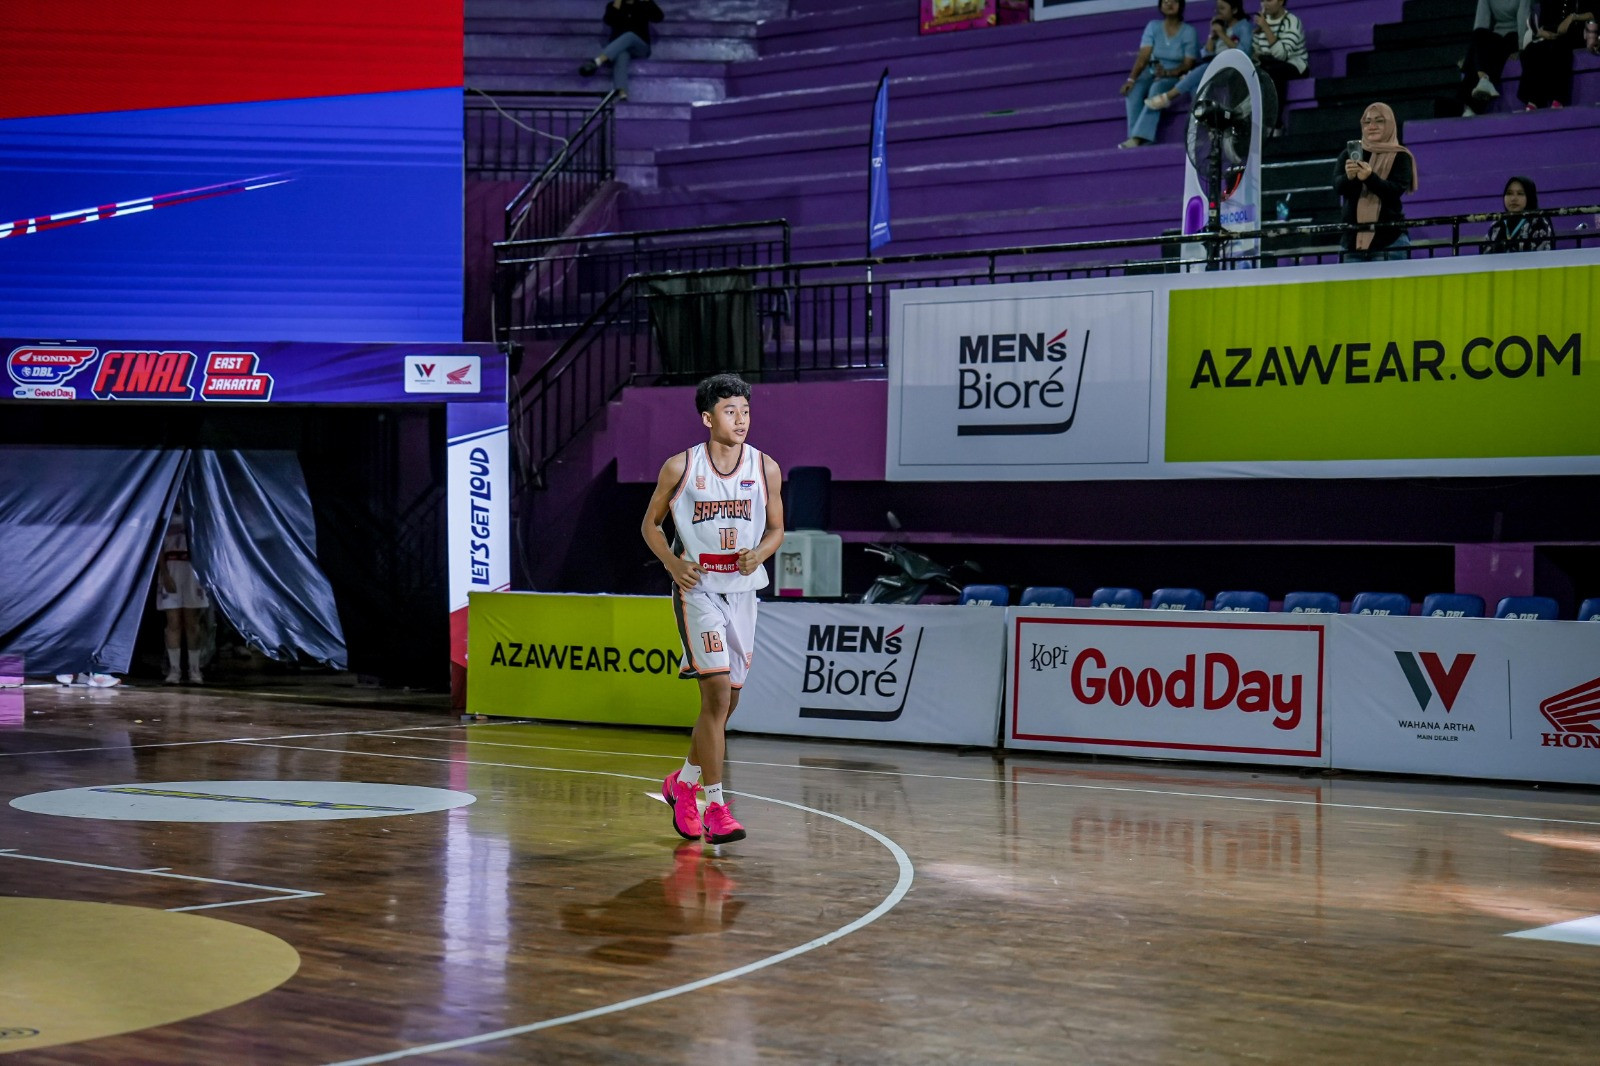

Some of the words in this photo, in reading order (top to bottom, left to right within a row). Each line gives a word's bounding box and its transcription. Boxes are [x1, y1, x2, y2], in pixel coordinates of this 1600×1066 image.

[31, 366, 54, 377] DBL
[32, 355, 77, 363] HONDA
[94, 352, 192, 392] FINAL
[213, 357, 244, 370] EAST
[1190, 333, 1582, 389] AZAWEAR.COM
[208, 378, 261, 391] JAKARTA
[957, 366, 1065, 410] Bioré
[469, 447, 491, 501] LOUD
[471, 498, 491, 539] GET
[719, 527, 738, 550] 18
[470, 540, 490, 585] LET'S
[701, 631, 723, 653] 18
[801, 655, 898, 698] Bioré
[1398, 720, 1440, 730] WAHANA
[1443, 722, 1475, 732] ARTHA
